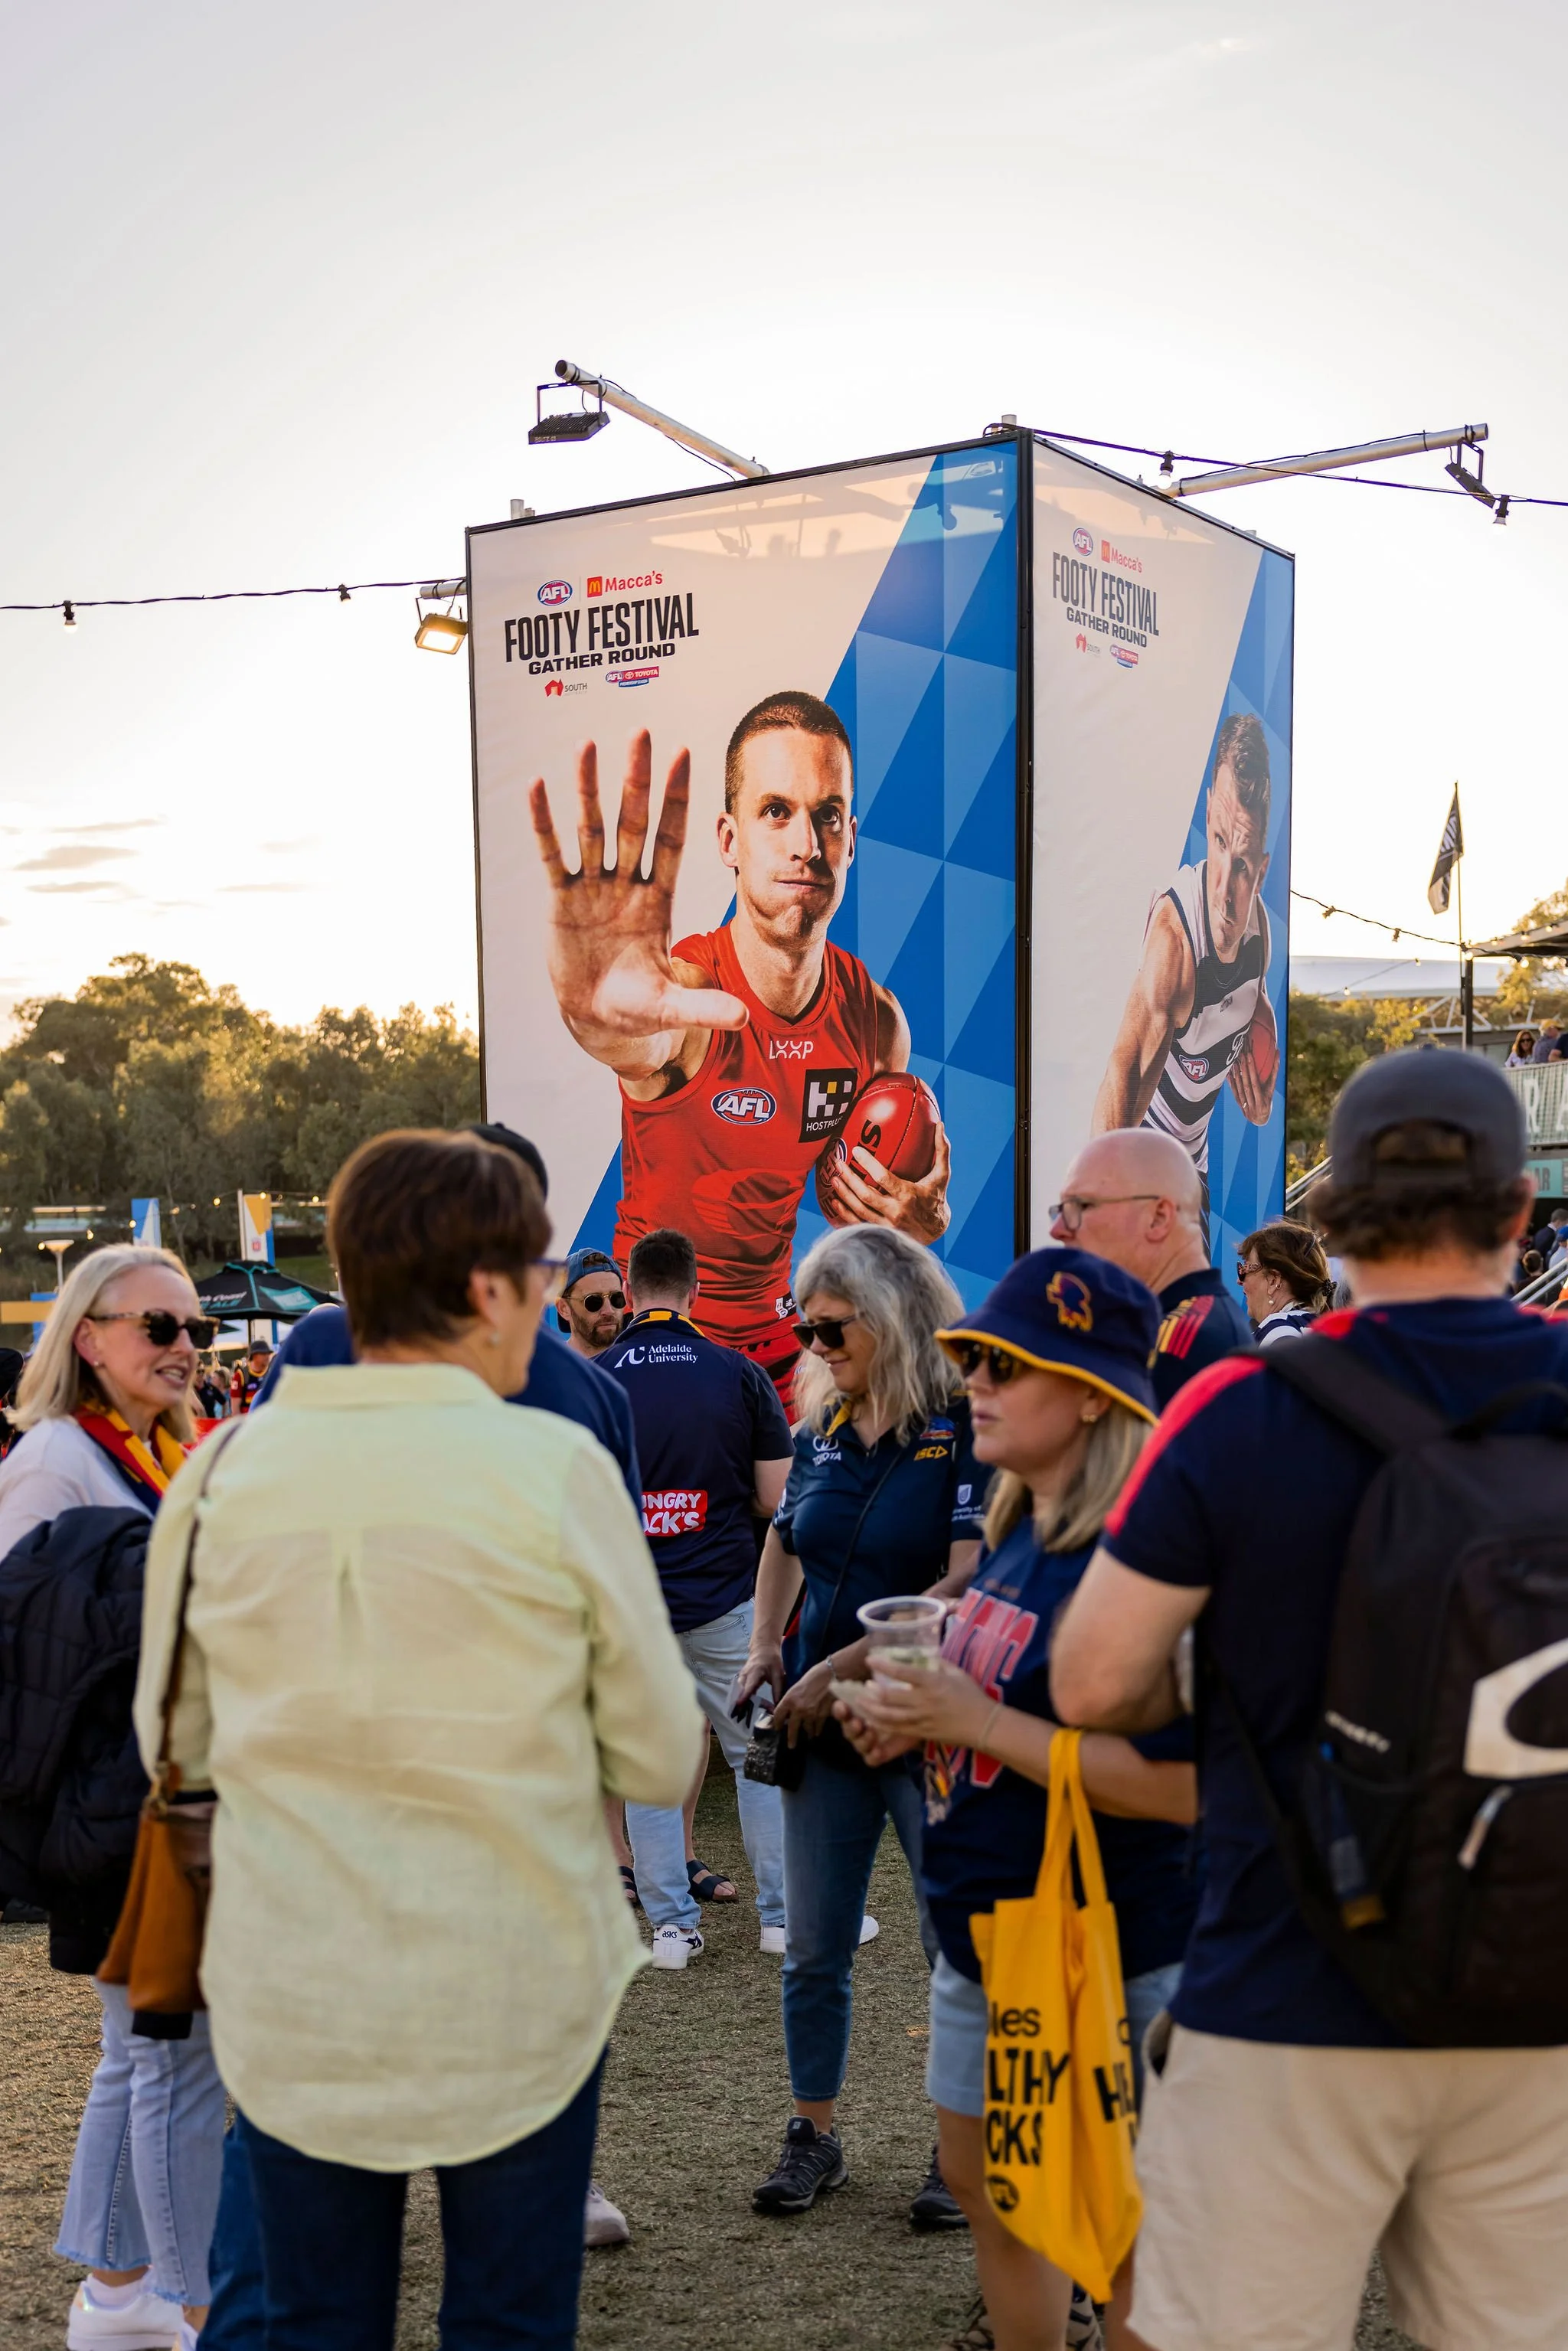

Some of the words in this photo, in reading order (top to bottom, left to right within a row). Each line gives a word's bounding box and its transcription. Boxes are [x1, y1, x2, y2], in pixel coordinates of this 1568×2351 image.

[1075, 533, 1093, 552] AFL
[1112, 547, 1142, 573] Macca's
[605, 570, 663, 593] Macca's
[540, 585, 570, 602] AFL
[1053, 551, 1097, 612] FOOTY
[1101, 570, 1159, 636] FESTIVAL
[505, 609, 580, 663] FOOTY
[588, 593, 699, 651] FESTIVAL
[1067, 606, 1109, 635] GATHER
[1112, 623, 1148, 648] ROUND
[528, 653, 603, 675] GATHER
[609, 643, 675, 664] ROUND
[635, 669, 658, 678] TOYOTA
[564, 682, 588, 693] SOUTH
[1181, 1060, 1207, 1077] AFL
[716, 1095, 769, 1118] AFL
[805, 1116, 843, 1132] HOSTPLU
[648, 1344, 692, 1354] Adelaide
[648, 1353, 698, 1363] University
[662, 1930, 678, 1938] asics
